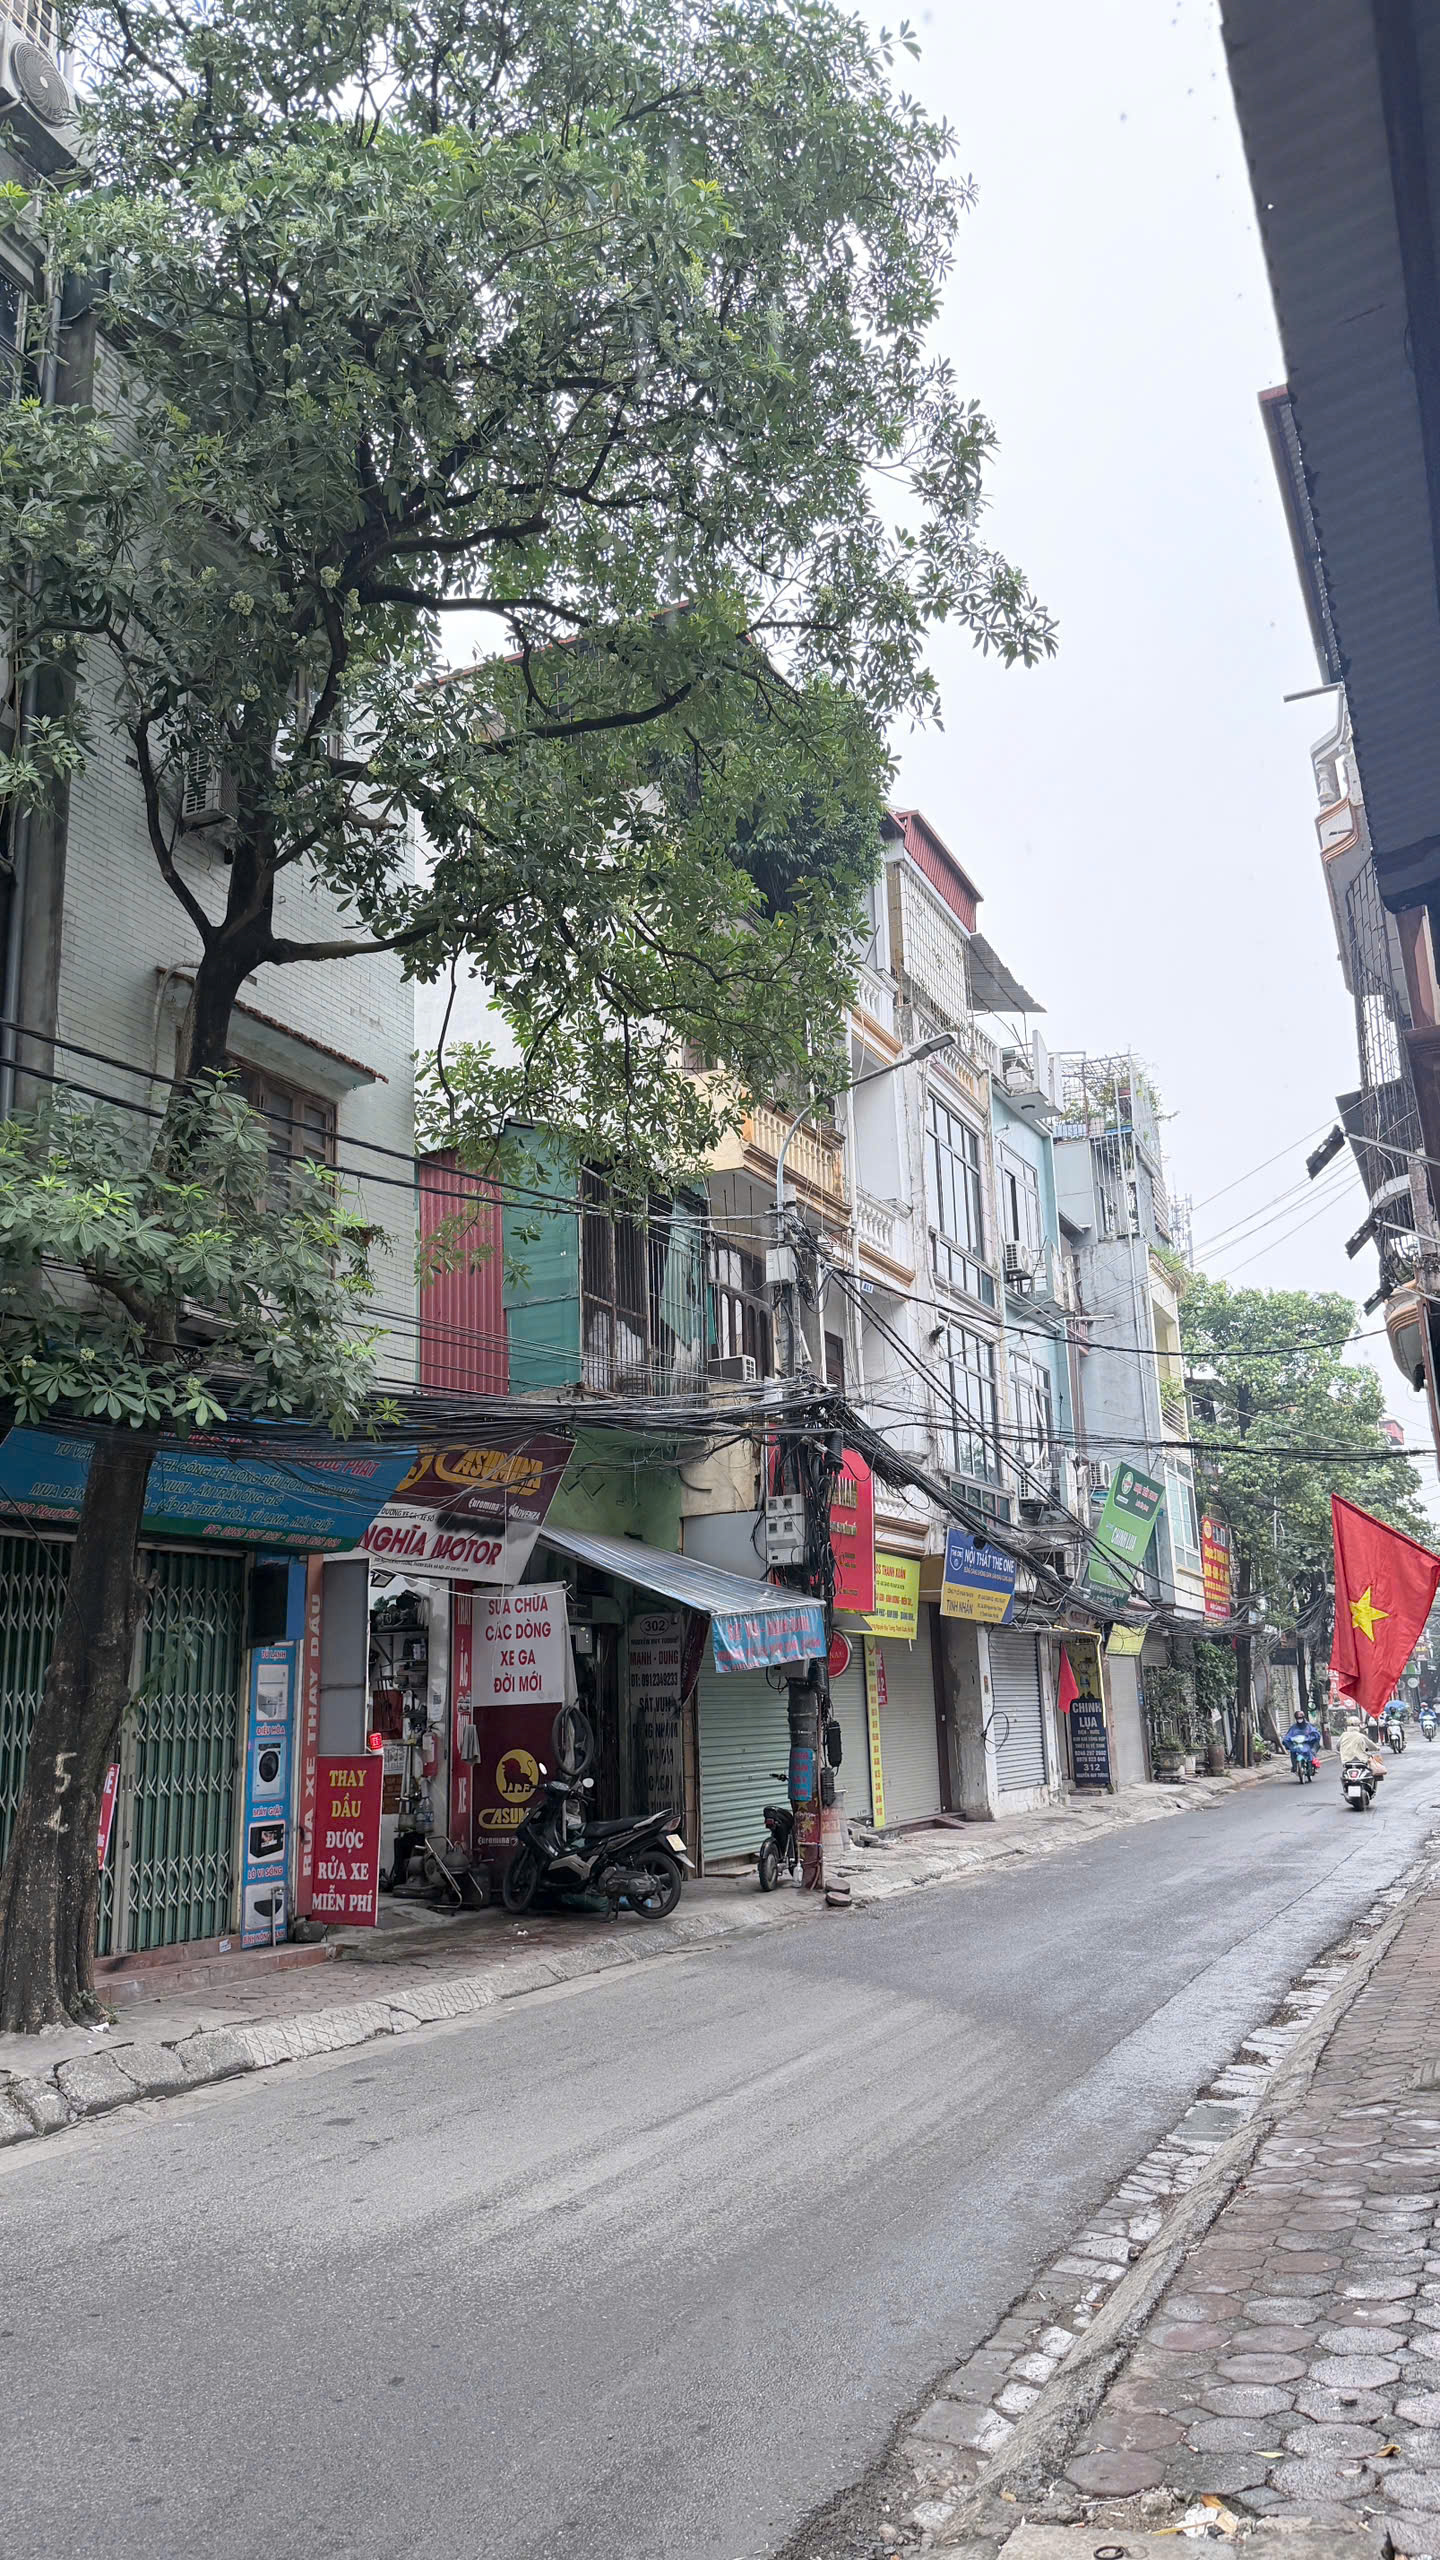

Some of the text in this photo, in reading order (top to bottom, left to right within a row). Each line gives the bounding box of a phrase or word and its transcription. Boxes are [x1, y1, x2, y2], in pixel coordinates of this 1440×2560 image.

[178, 1460, 212, 1477] CÔNG
[31, 1481, 60, 1498] MUA
[200, 1500, 223, 1518] ĐIỀU
[357, 1524, 503, 1566] NGHĨA MOTOR
[964, 1546, 1014, 1574] NỘI THẤT THE ONE
[485, 1618, 551, 1641] CÁC DÒNG
[644, 1620, 666, 1632] 302
[500, 1649, 536, 1666] XE GA
[494, 1670, 542, 1694] ĐỜI MỚI
[307, 1669, 320, 1746] THAY
[256, 1721, 270, 1736] ĐIỀU
[1079, 1716, 1098, 1729] LỤA
[304, 1756, 316, 1798] XE
[329, 1769, 368, 1788] THAY
[1083, 1763, 1101, 1771] 312
[252, 1805, 267, 1818] MÁY
[331, 1793, 361, 1818] DẦU
[325, 1828, 364, 1854] ĐƯỢC
[257, 1867, 265, 1878] VI
[264, 1863, 284, 1877] SÓNG
[317, 1855, 370, 1881] RỬA XE
[312, 1884, 373, 1913] MIỄN PHÍ
